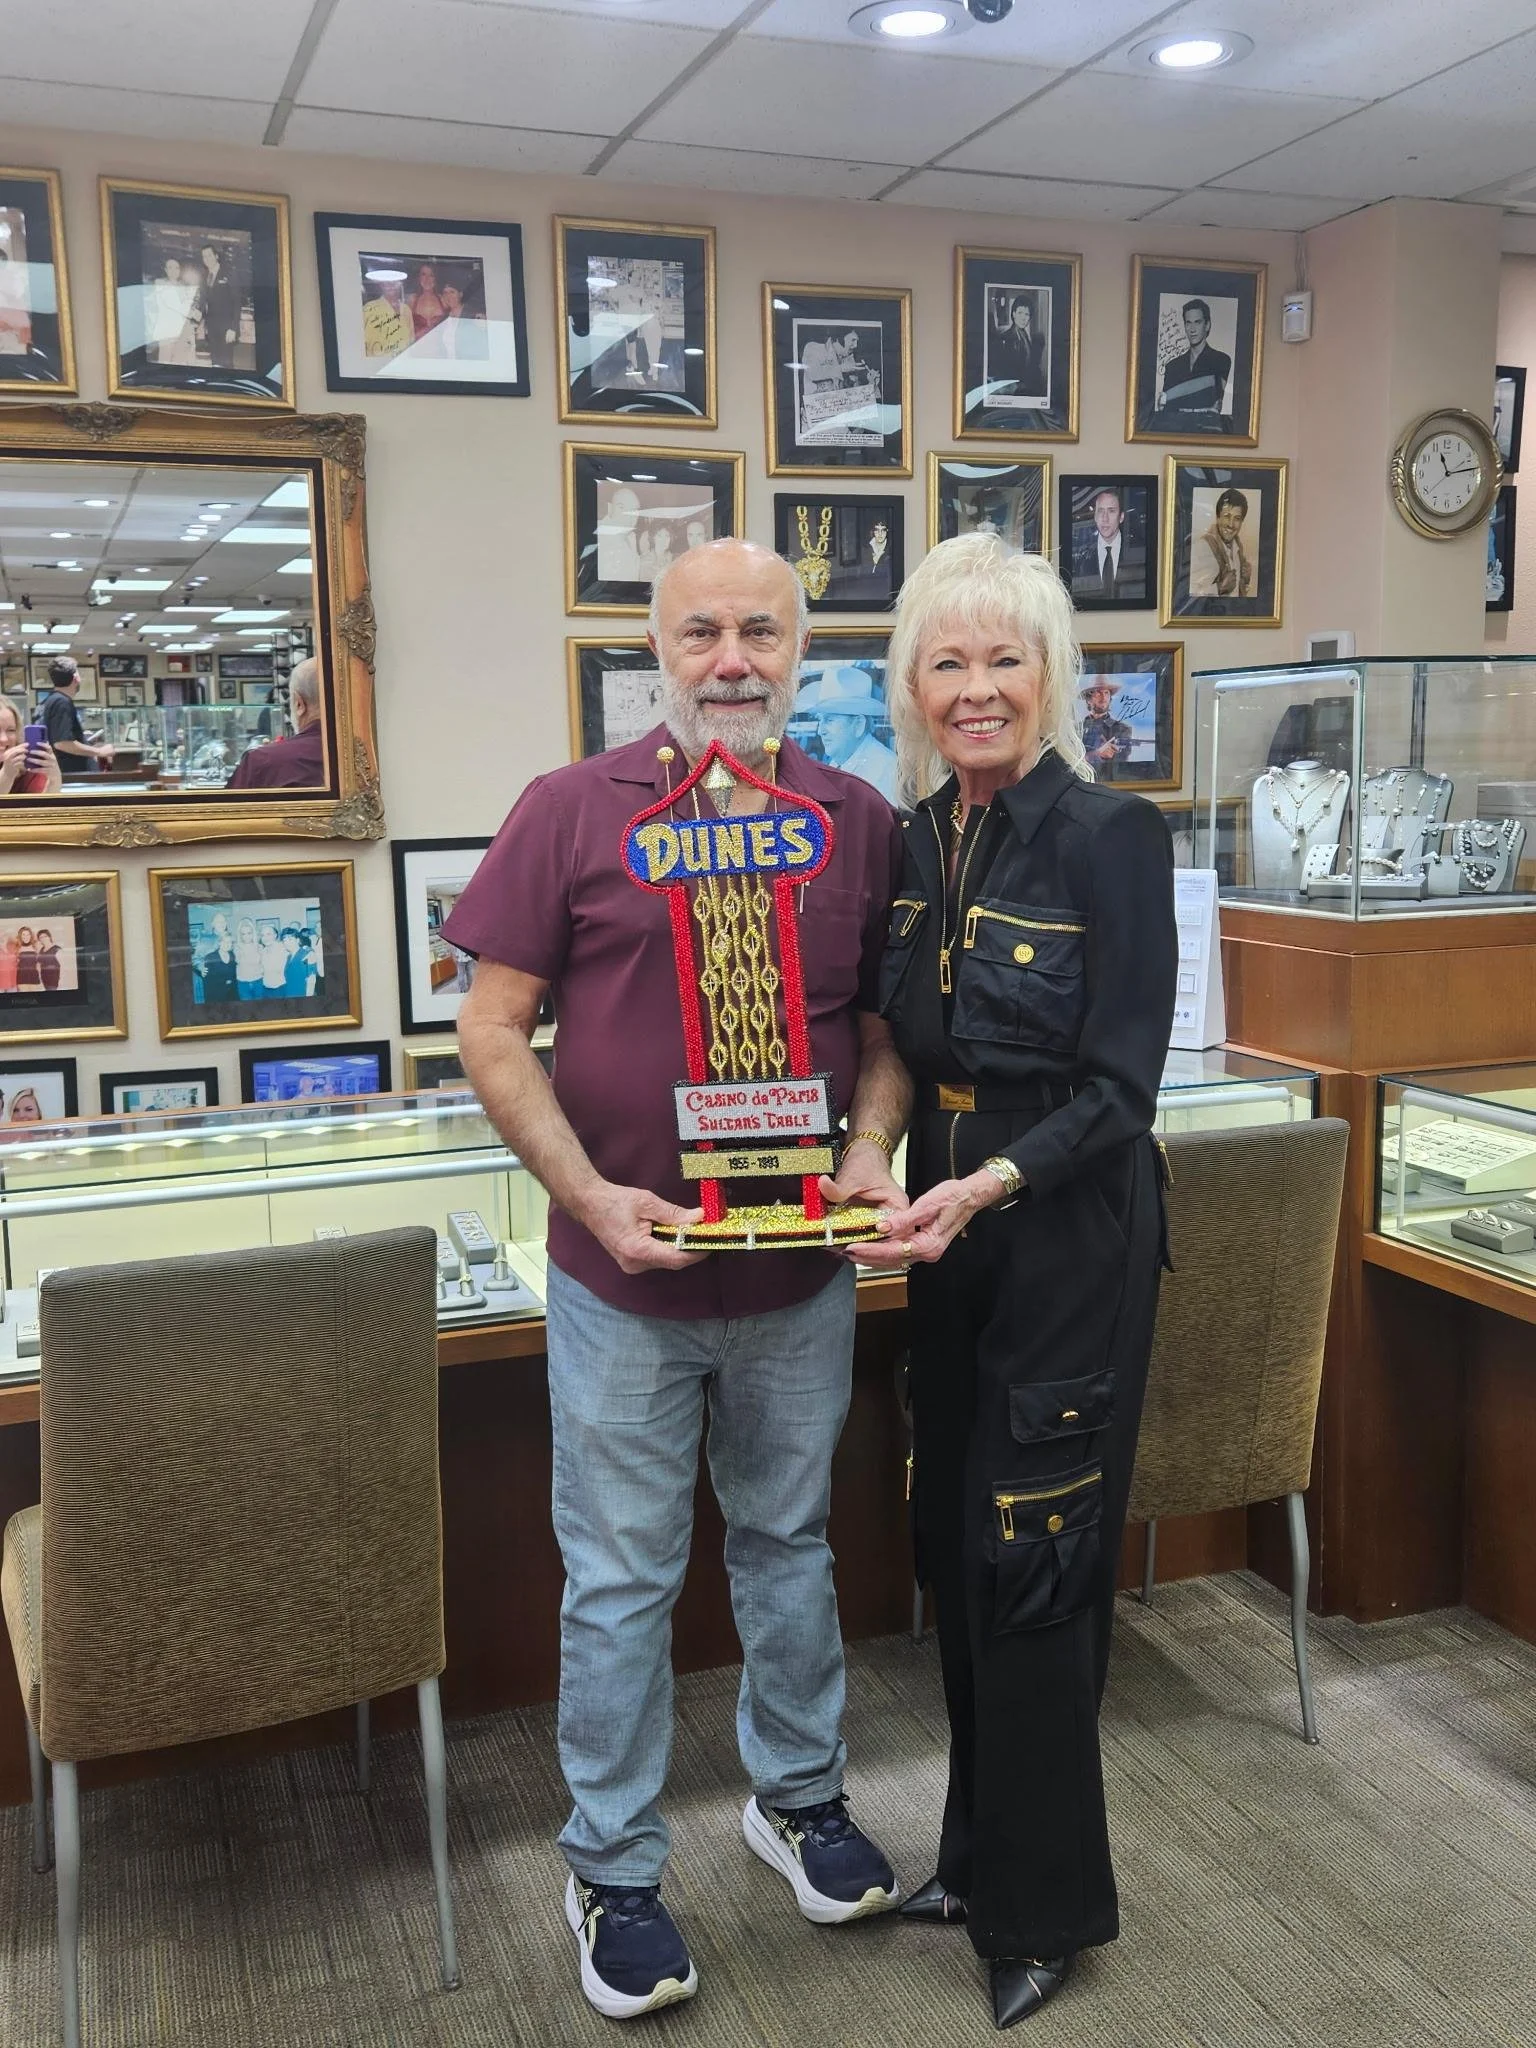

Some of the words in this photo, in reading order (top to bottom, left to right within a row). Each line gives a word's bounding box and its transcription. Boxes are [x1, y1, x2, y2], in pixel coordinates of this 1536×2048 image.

[635, 817, 813, 883] DUNES
[751, 1090, 768, 1106] de
[763, 1112, 812, 1130] TABLE
[727, 1157, 750, 1171] 1955
